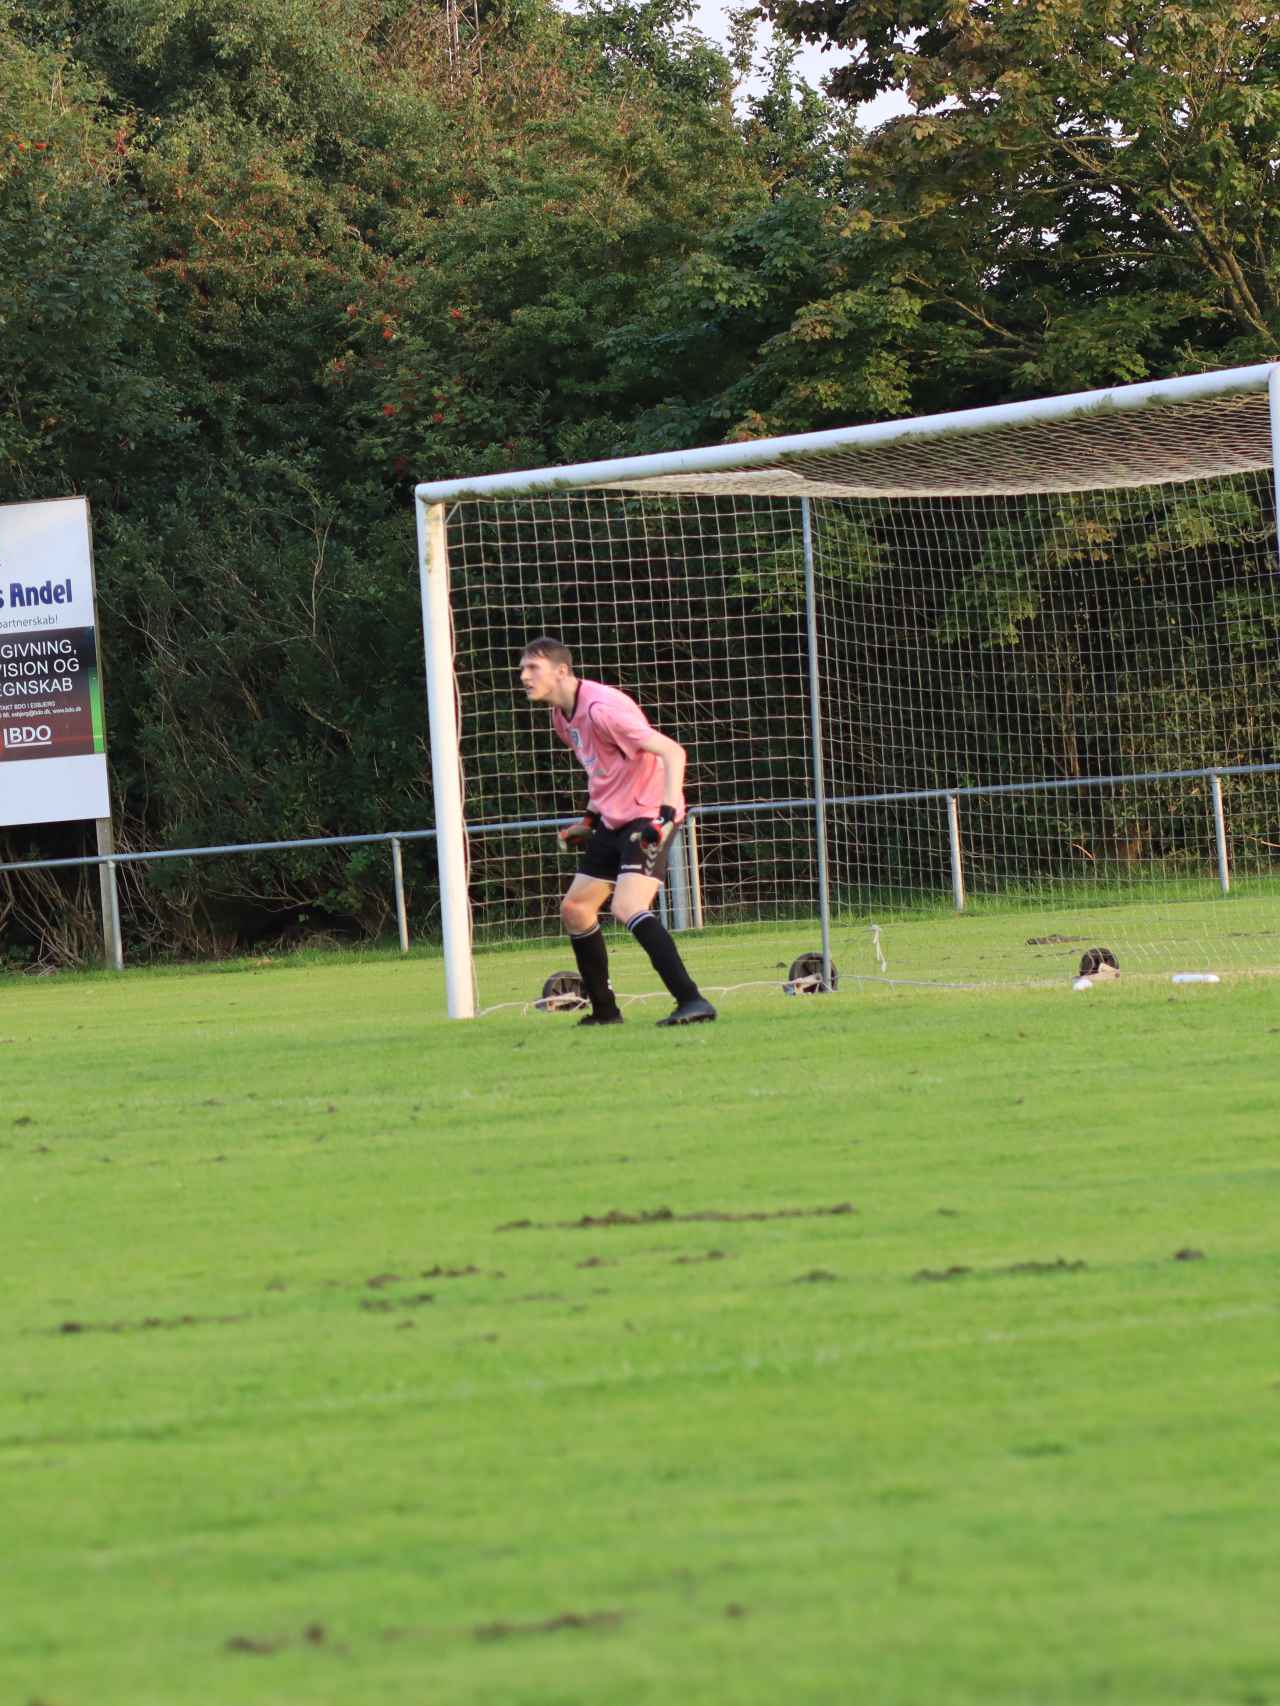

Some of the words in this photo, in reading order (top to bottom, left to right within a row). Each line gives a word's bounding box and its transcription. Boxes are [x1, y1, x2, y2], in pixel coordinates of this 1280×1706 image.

[9, 579, 73, 608] Andel
[53, 658, 80, 673] OG
[9, 725, 52, 743] BDO
